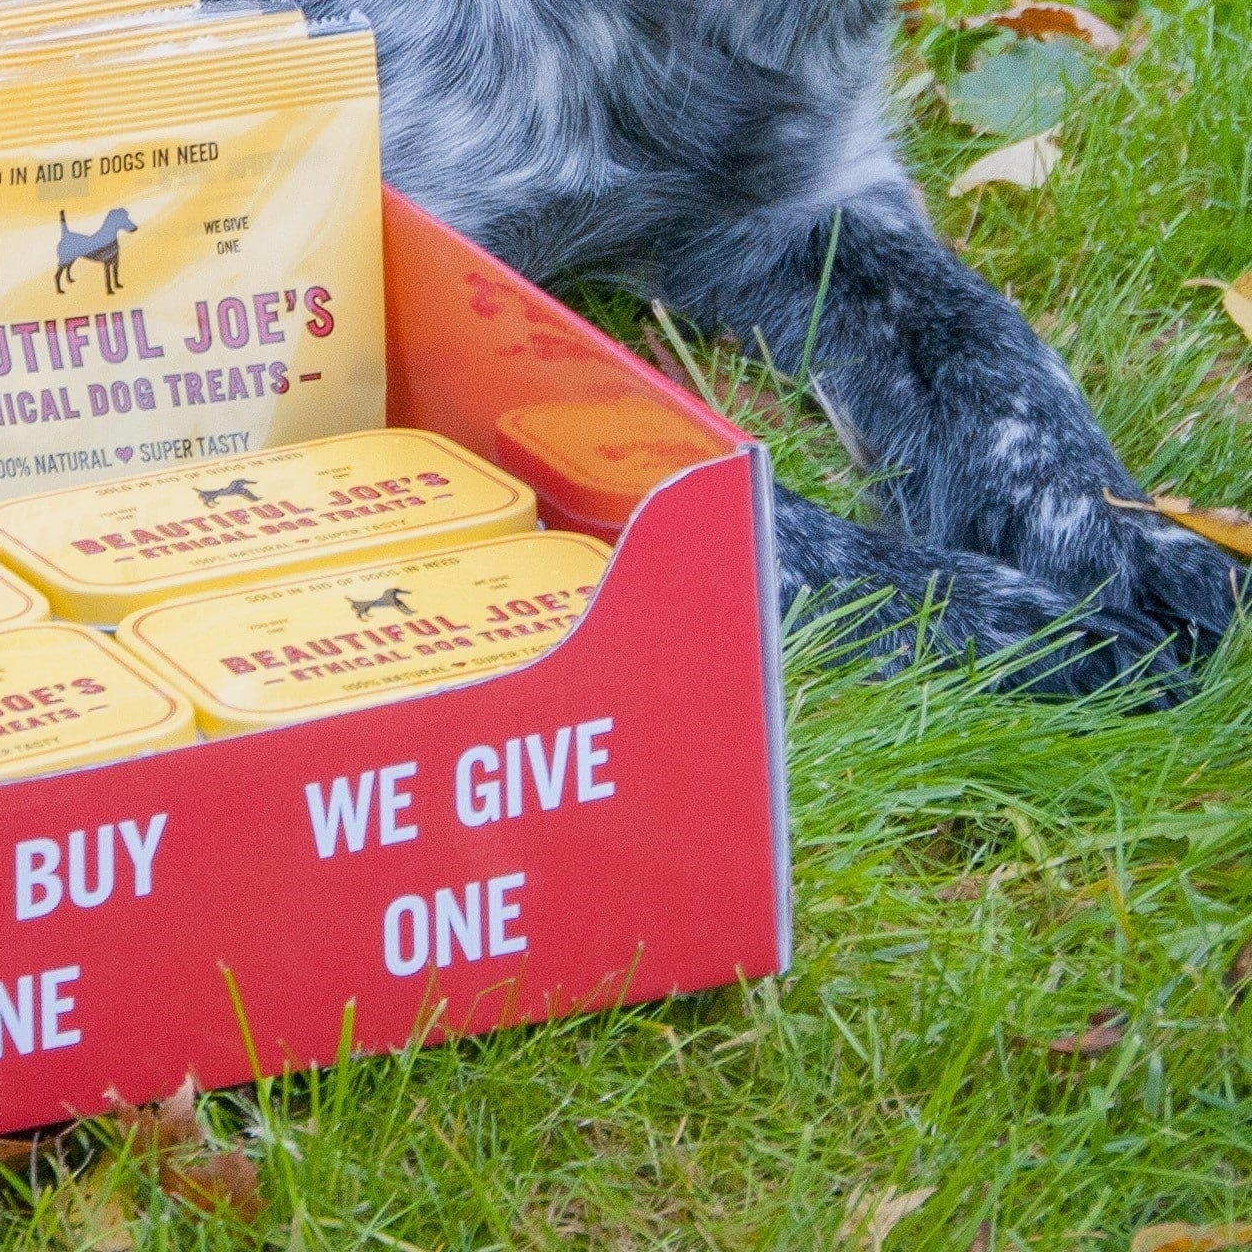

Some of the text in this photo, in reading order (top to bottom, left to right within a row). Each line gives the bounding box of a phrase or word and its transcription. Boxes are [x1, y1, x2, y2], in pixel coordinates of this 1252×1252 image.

[9, 166, 28, 186] IN
[35, 163, 64, 184] AID
[71, 159, 93, 180] OF
[99, 153, 146, 177] DOGS
[151, 148, 170, 169] IN
[176, 141, 220, 165] NEED
[203, 215, 250, 235] WE GIVE
[215, 238, 241, 256] ONE
[182, 285, 336, 354] JOE'S
[89, 375, 157, 416] DOG
[162, 360, 290, 410] TREATS
[34, 448, 114, 477] NATURAL
[139, 436, 193, 464] SUPER
[194, 430, 251, 458] TASTY
[70, 471, 452, 556] BEAUTIFUL JOE'S
[138, 496, 427, 560] ETHICAL DOG TREATS
[220, 614, 471, 676] BEAUTIFUL
[289, 651, 411, 683] ETHICAL
[413, 636, 474, 657] DOG
[304, 716, 616, 860] WE GIVE
[14, 812, 170, 922] BUY
[382, 871, 530, 979] ONE
